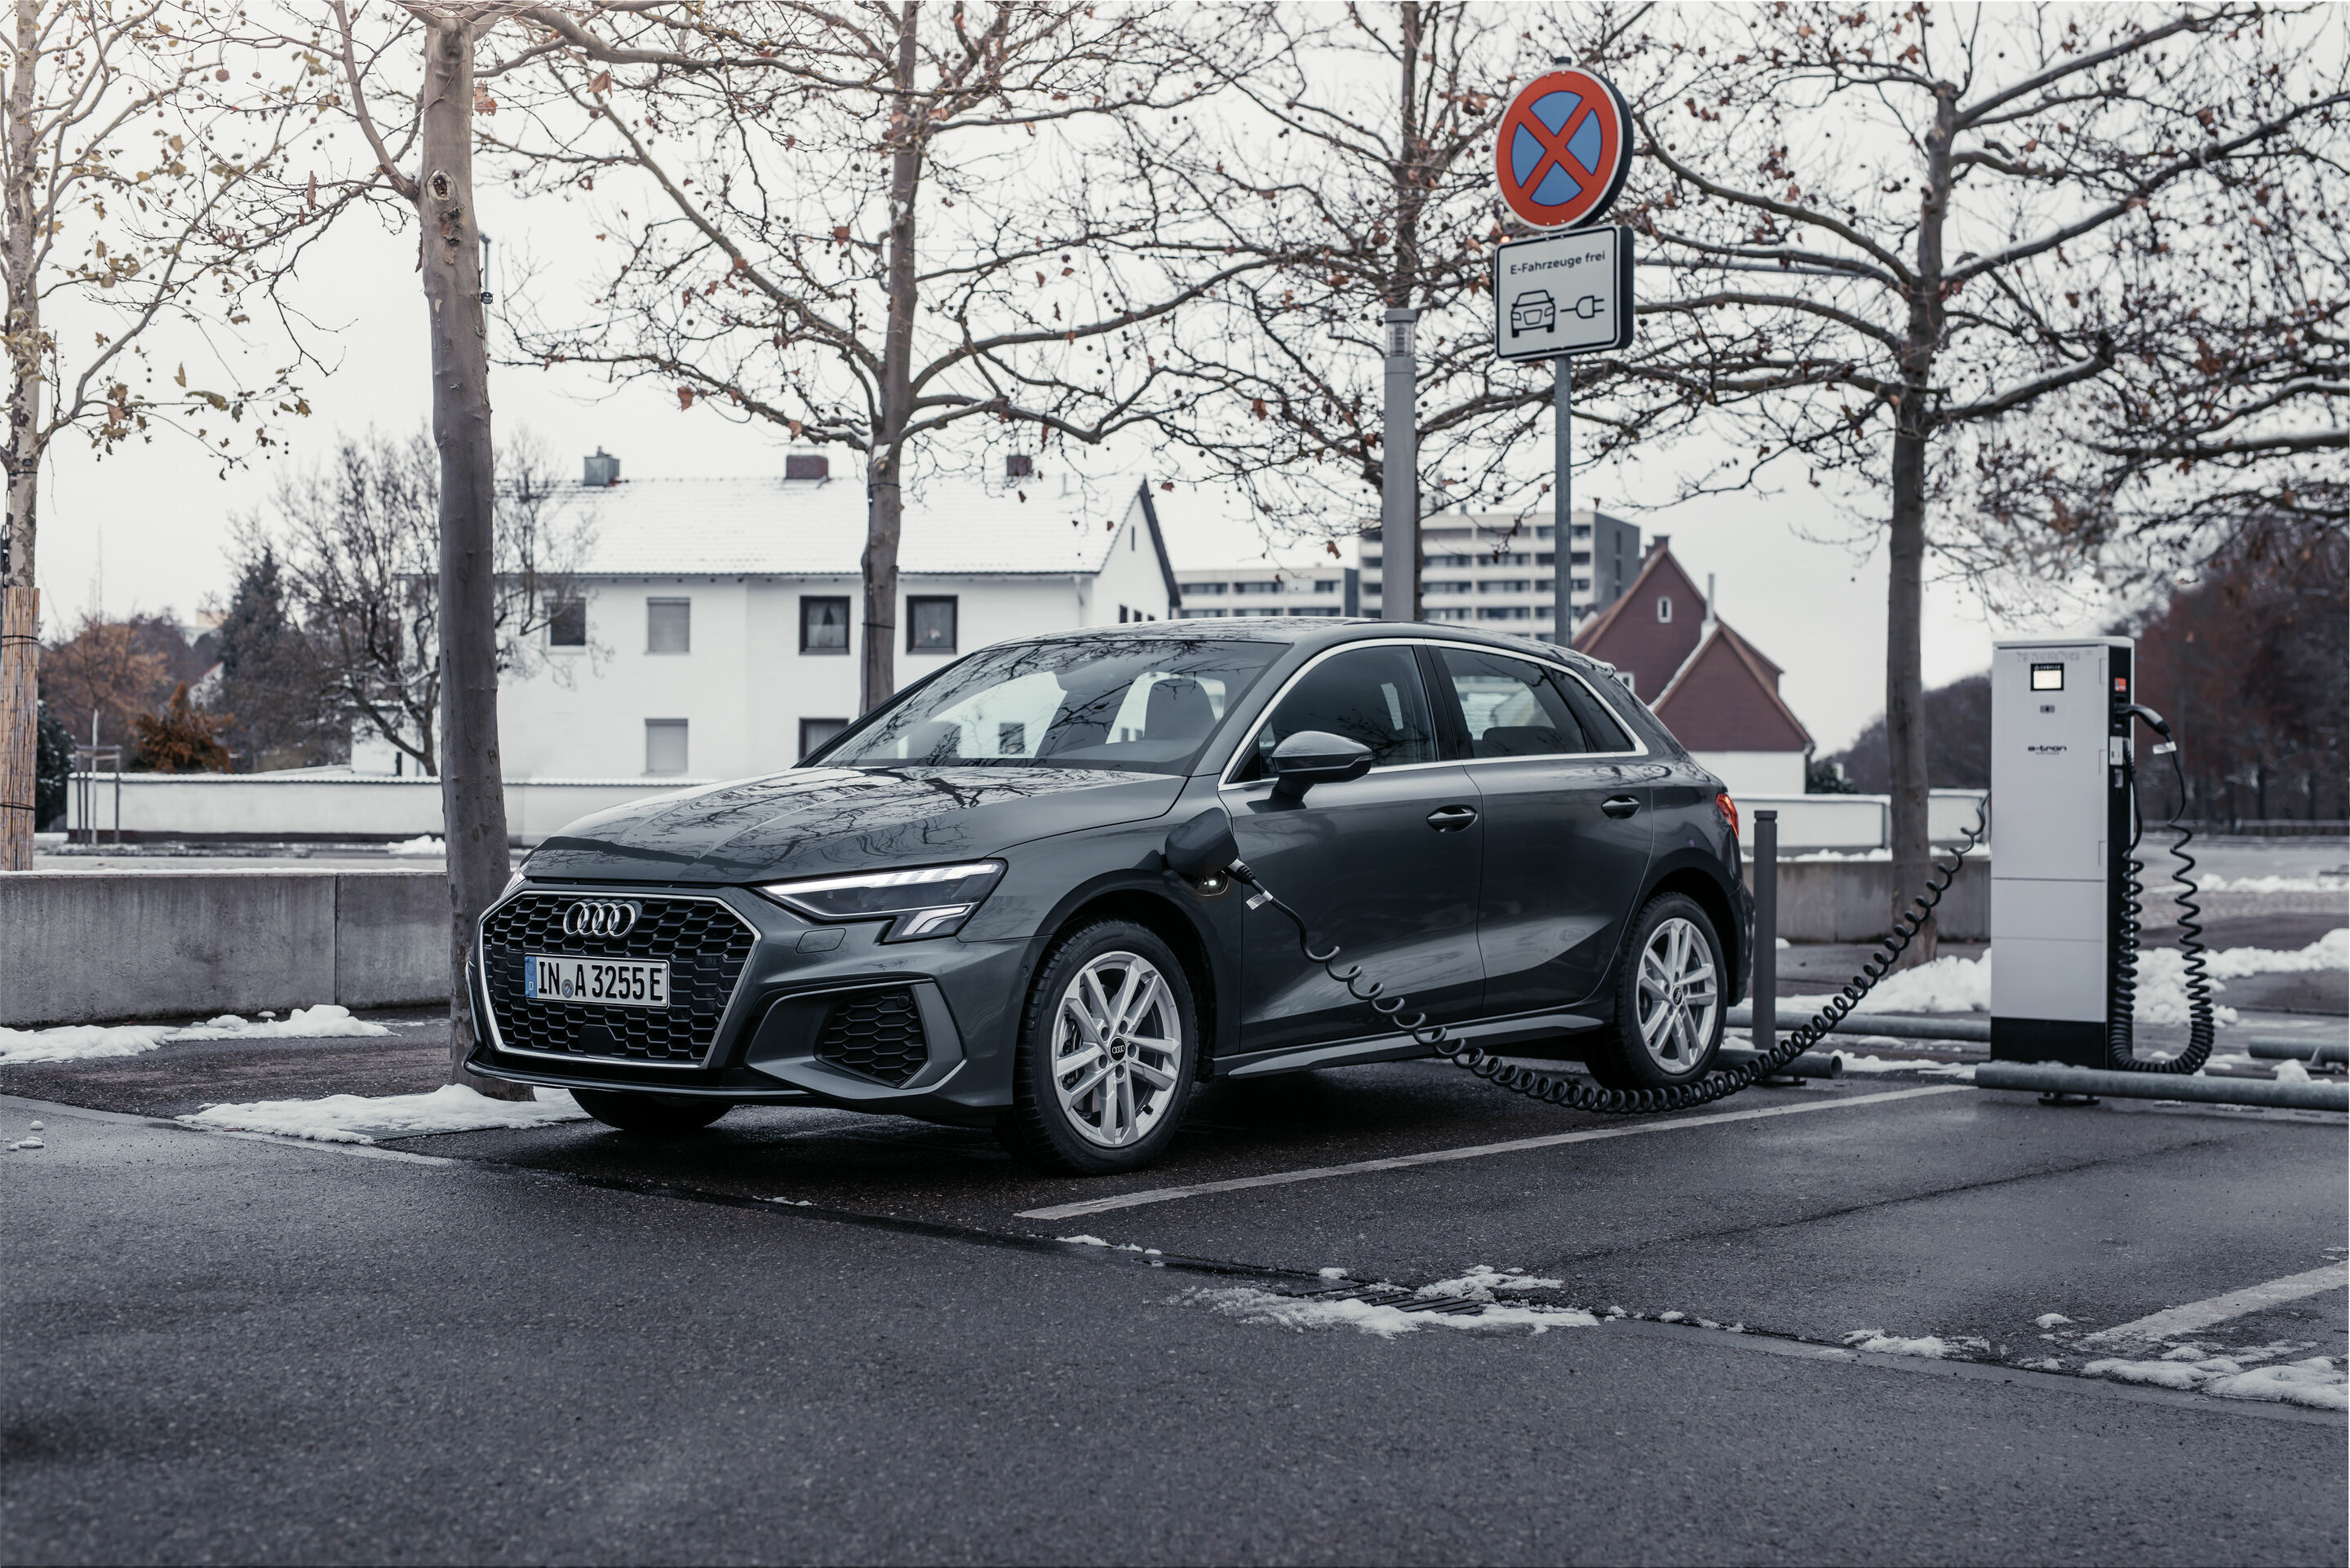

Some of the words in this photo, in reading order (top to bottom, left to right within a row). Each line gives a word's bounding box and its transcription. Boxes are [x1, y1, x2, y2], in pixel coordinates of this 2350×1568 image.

[1510, 255, 1582, 275] E-Fahrzeuge
[1585, 250, 1606, 263] frei
[539, 962, 560, 994] IN
[574, 963, 586, 997] A
